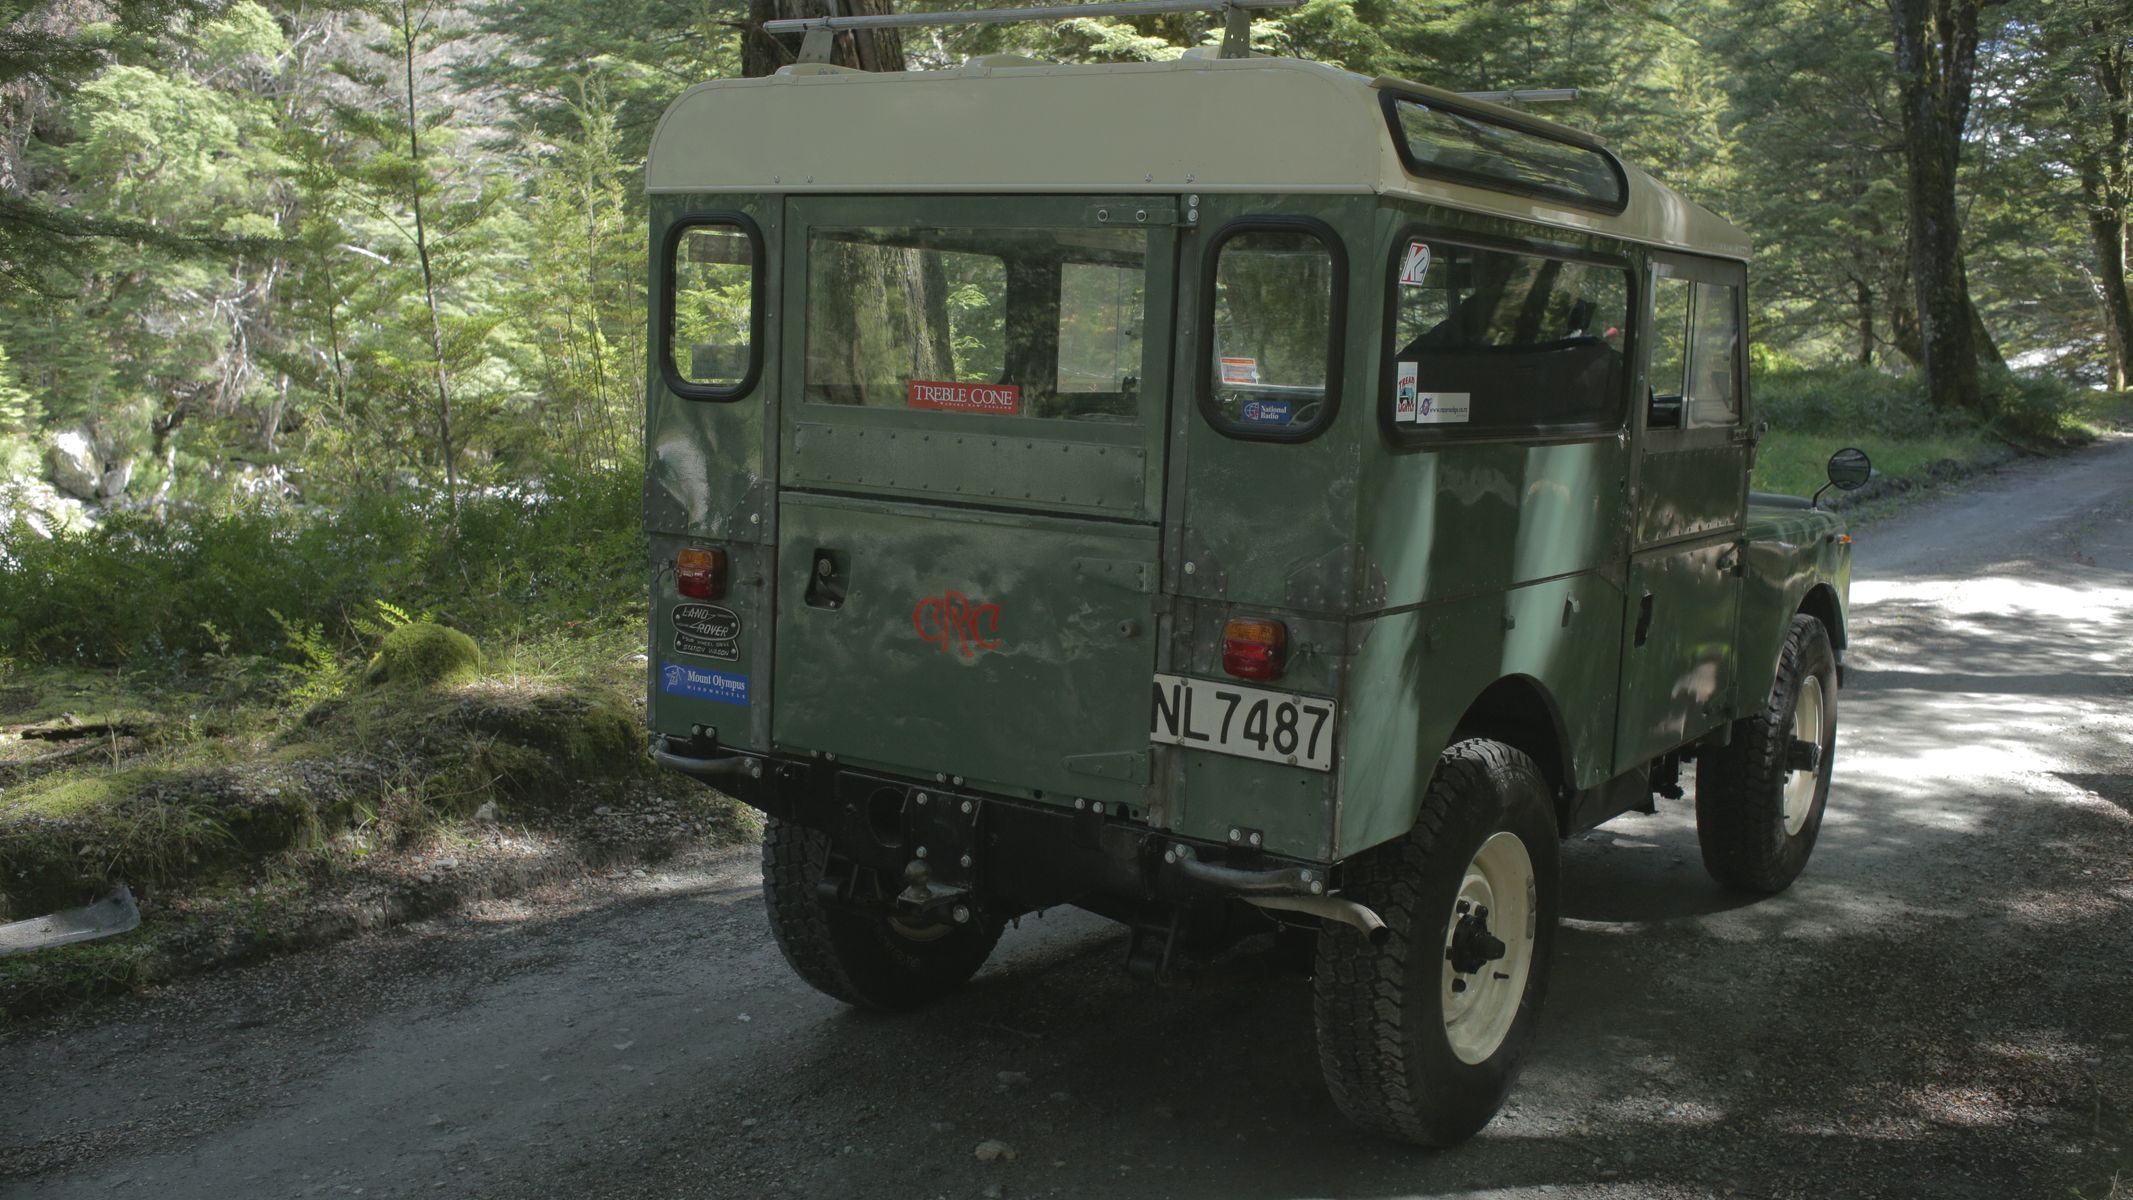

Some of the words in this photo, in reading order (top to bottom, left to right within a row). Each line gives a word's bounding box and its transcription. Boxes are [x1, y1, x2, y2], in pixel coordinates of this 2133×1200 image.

[914, 385, 967, 402] TREBLE
[971, 388, 1012, 405] CONE
[1261, 405, 1287, 413] National
[1261, 411, 1279, 419] Radio
[682, 607, 708, 619] LAND
[697, 623, 728, 637] ROVER
[682, 644, 706, 653] STATION
[708, 647, 730, 656] WAGON
[687, 670, 711, 684] Mount
[713, 675, 745, 691] Olympus
[1151, 682, 1329, 760] NL7487
